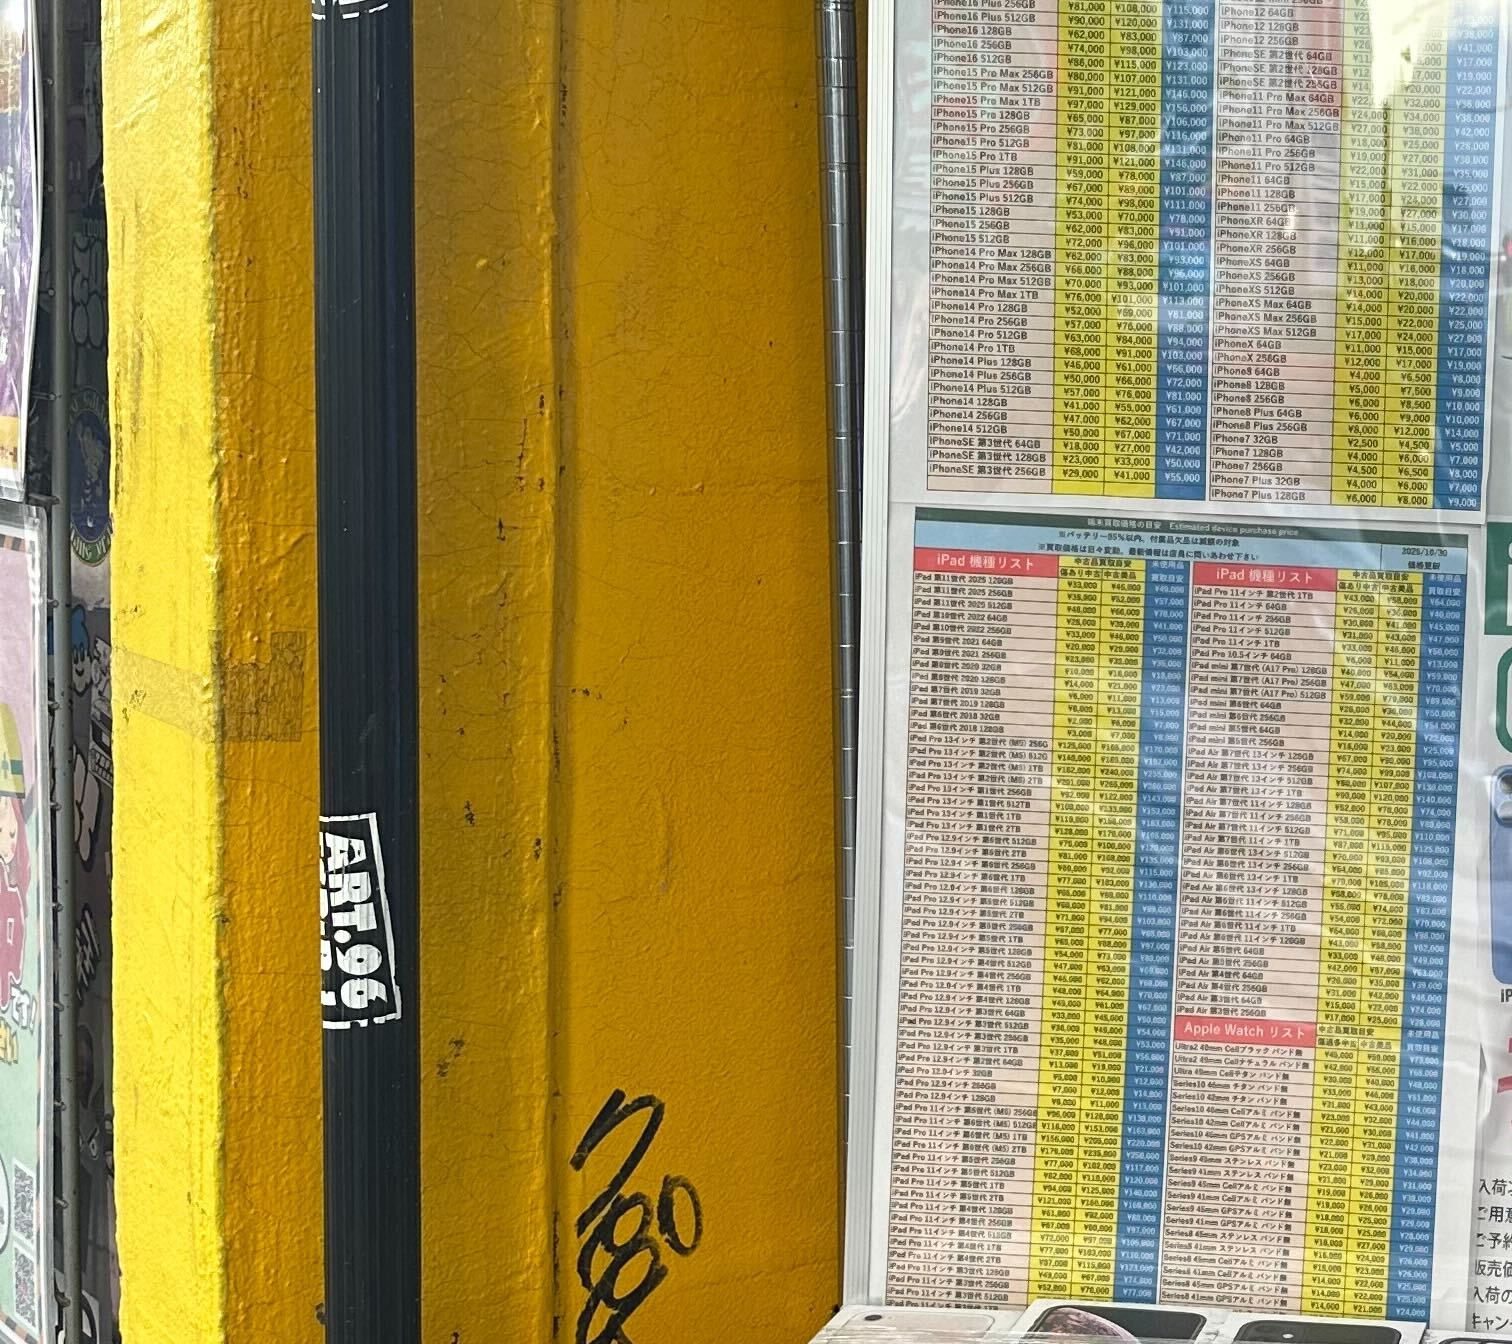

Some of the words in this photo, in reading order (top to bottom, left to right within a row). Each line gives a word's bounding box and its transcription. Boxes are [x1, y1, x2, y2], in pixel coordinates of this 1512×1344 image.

[1213, 434, 1250, 444] iPhone7
[1253, 435, 1278, 444] 32GB
[1348, 439, 1378, 448] ¥2,500
[1399, 440, 1429, 450] ¥4,500
[937, 554, 965, 567] iPad
[970, 555, 1034, 571] 機種リスト
[1216, 568, 1245, 581] iPad
[1249, 570, 1313, 584] 機種リスト
[1184, 1022, 1220, 1037] Apple
[1224, 1023, 1264, 1038] Watch
[1269, 1026, 1305, 1040] リスト
